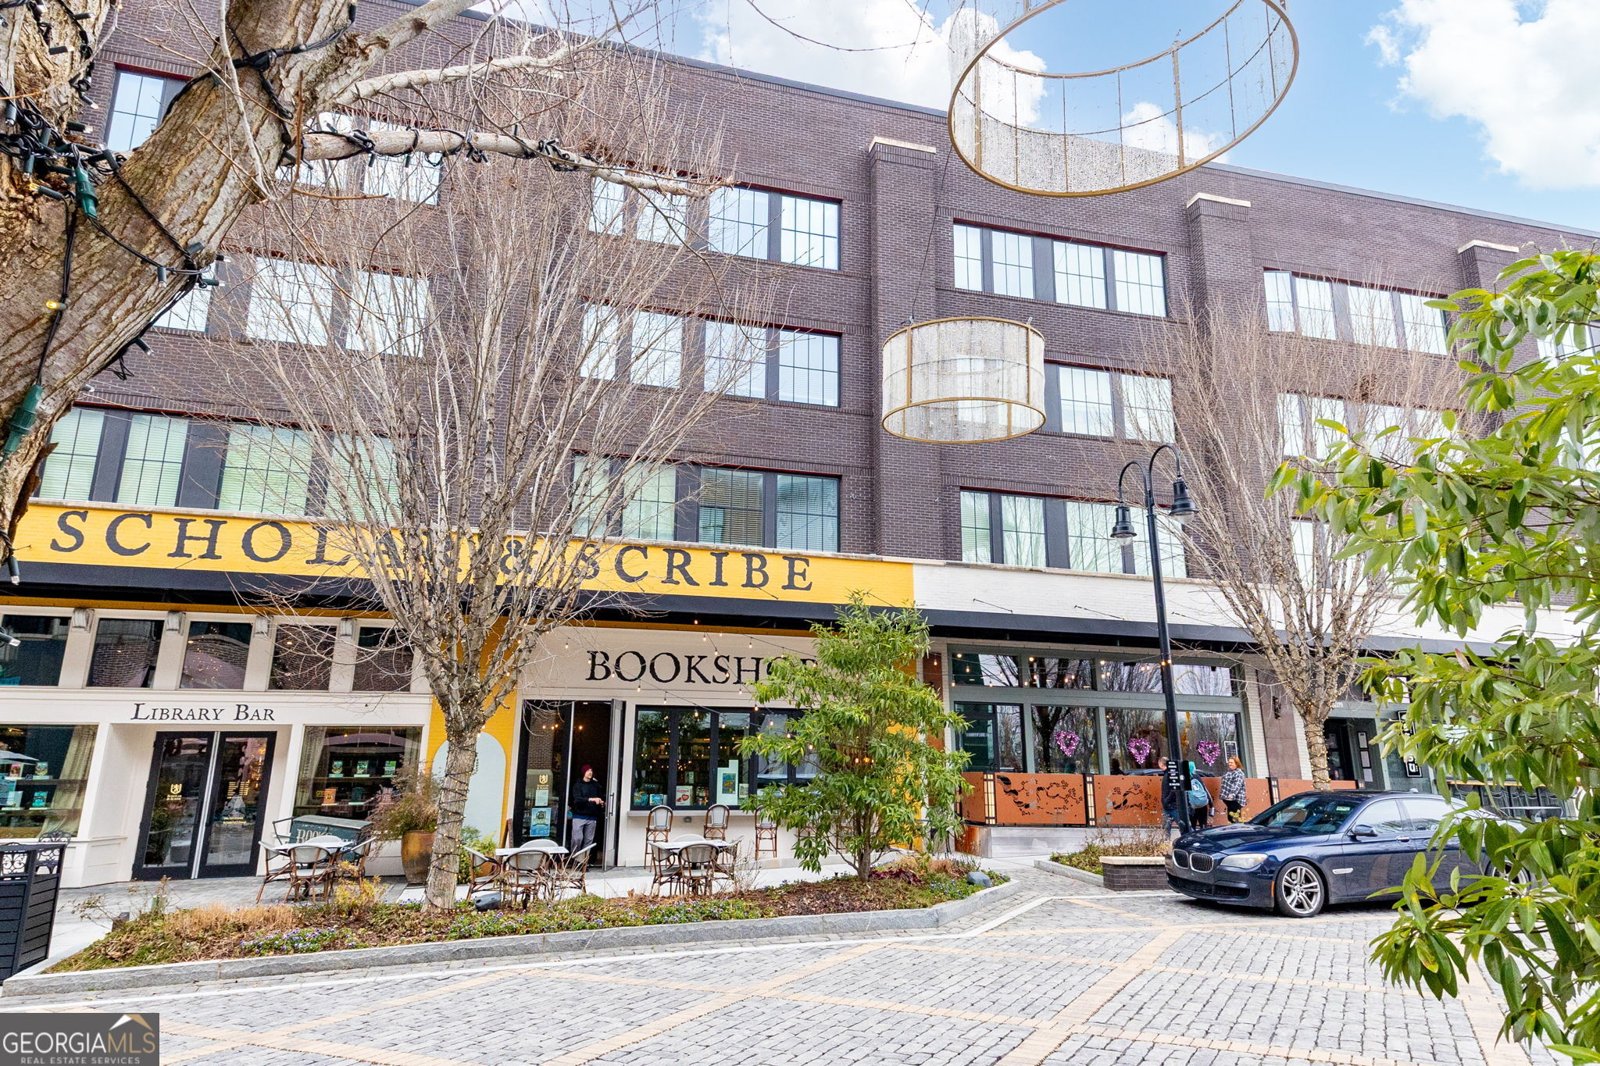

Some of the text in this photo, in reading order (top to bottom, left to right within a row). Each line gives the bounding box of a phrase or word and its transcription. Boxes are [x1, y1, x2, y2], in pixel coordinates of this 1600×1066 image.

[500, 539, 539, 576] &
[572, 543, 813, 591] SCRIBE
[296, 829, 332, 844] BOO
